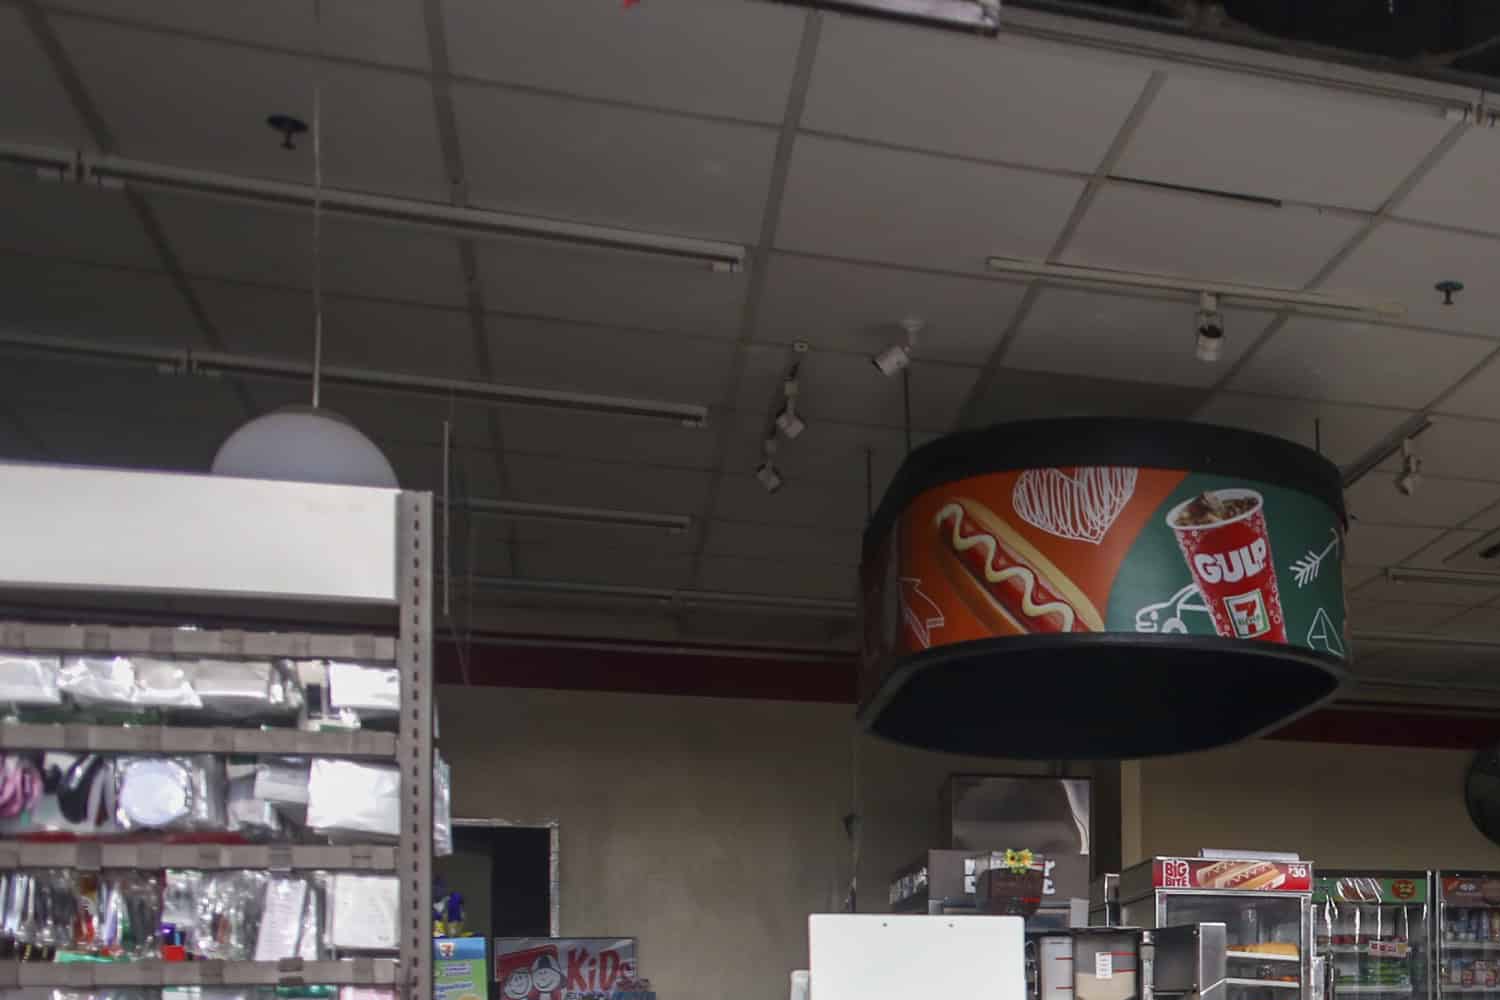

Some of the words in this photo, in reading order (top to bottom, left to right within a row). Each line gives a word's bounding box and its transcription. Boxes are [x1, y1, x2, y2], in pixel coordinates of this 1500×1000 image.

[1194, 537, 1267, 583] GULP
[1165, 861, 1188, 877] BIG
[1165, 877, 1189, 888] BITE
